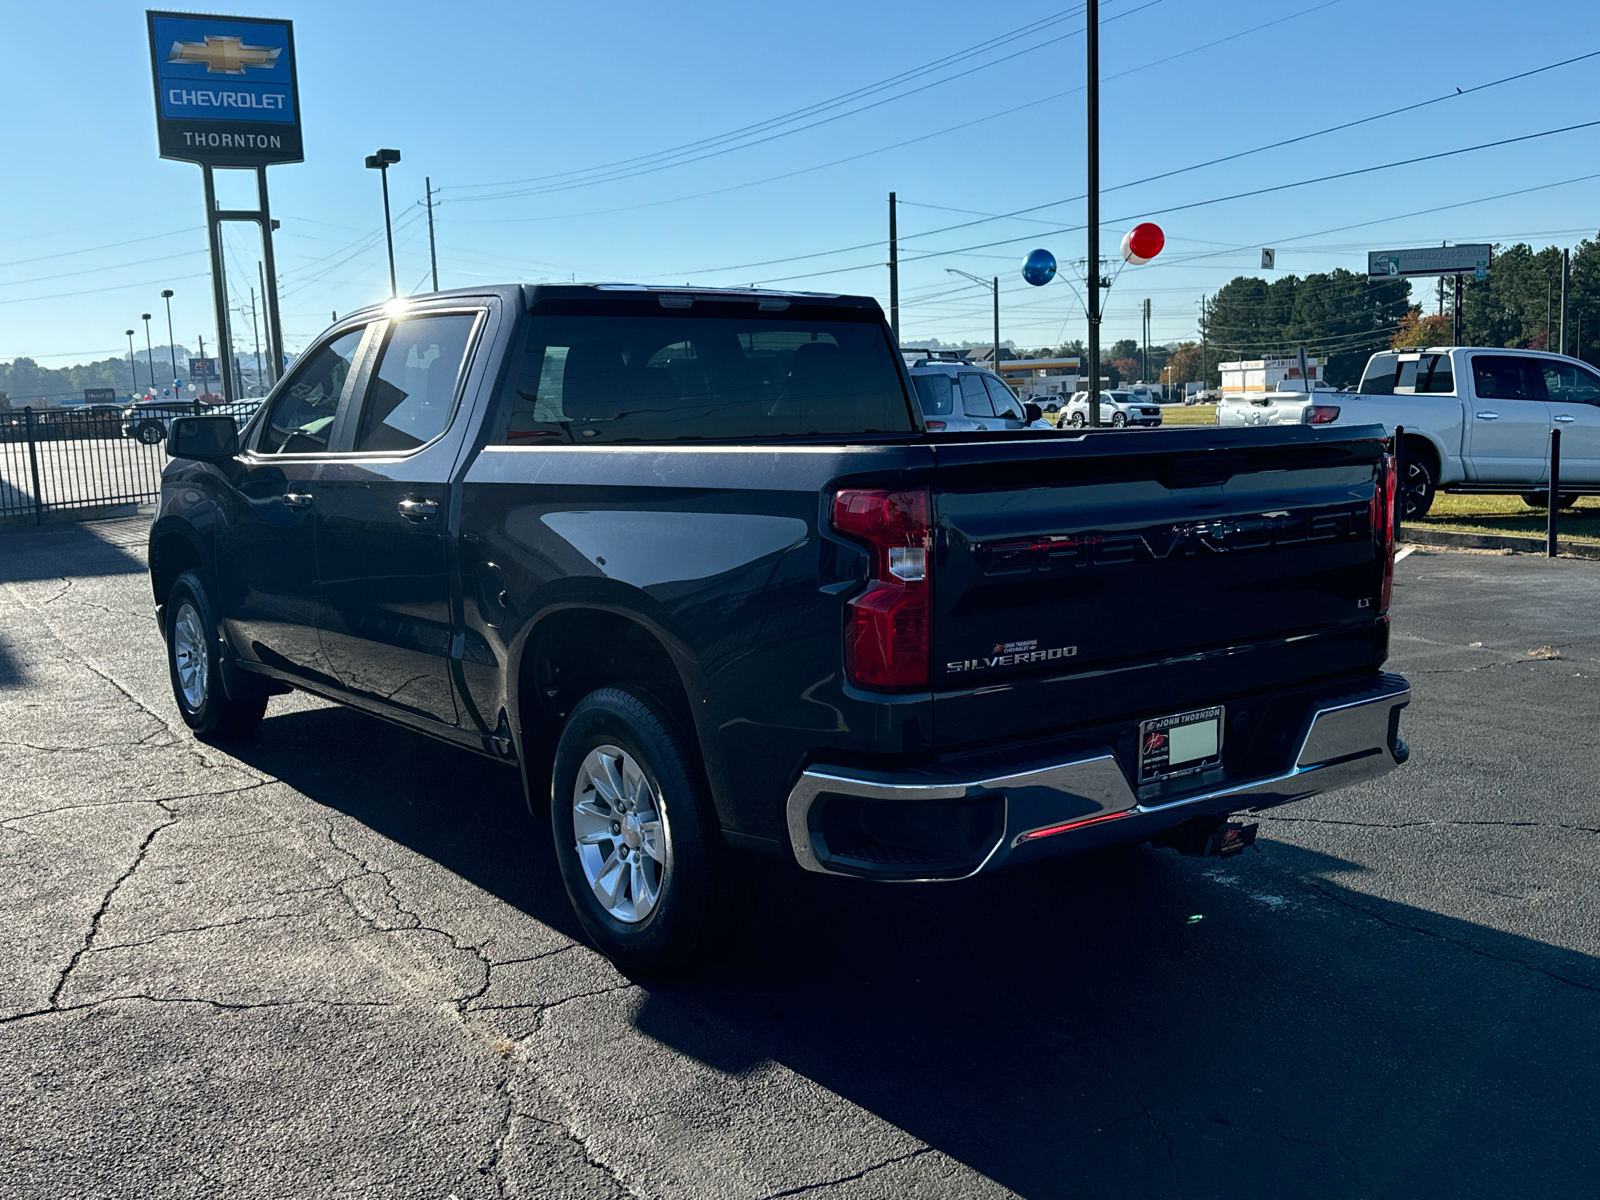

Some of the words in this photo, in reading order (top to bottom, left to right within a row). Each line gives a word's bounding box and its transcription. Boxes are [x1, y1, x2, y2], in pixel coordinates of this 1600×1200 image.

[169, 89, 285, 109] CHEVROLET
[183, 131, 281, 148] THORNTON
[1278, 359, 1298, 367] EMISSI
[984, 508, 1369, 577] CHEVROLET
[1357, 597, 1373, 609] LT
[946, 645, 1078, 673] SILVERADO
[1159, 716, 1180, 728] JOHN
[1181, 708, 1221, 723] THORNTON
